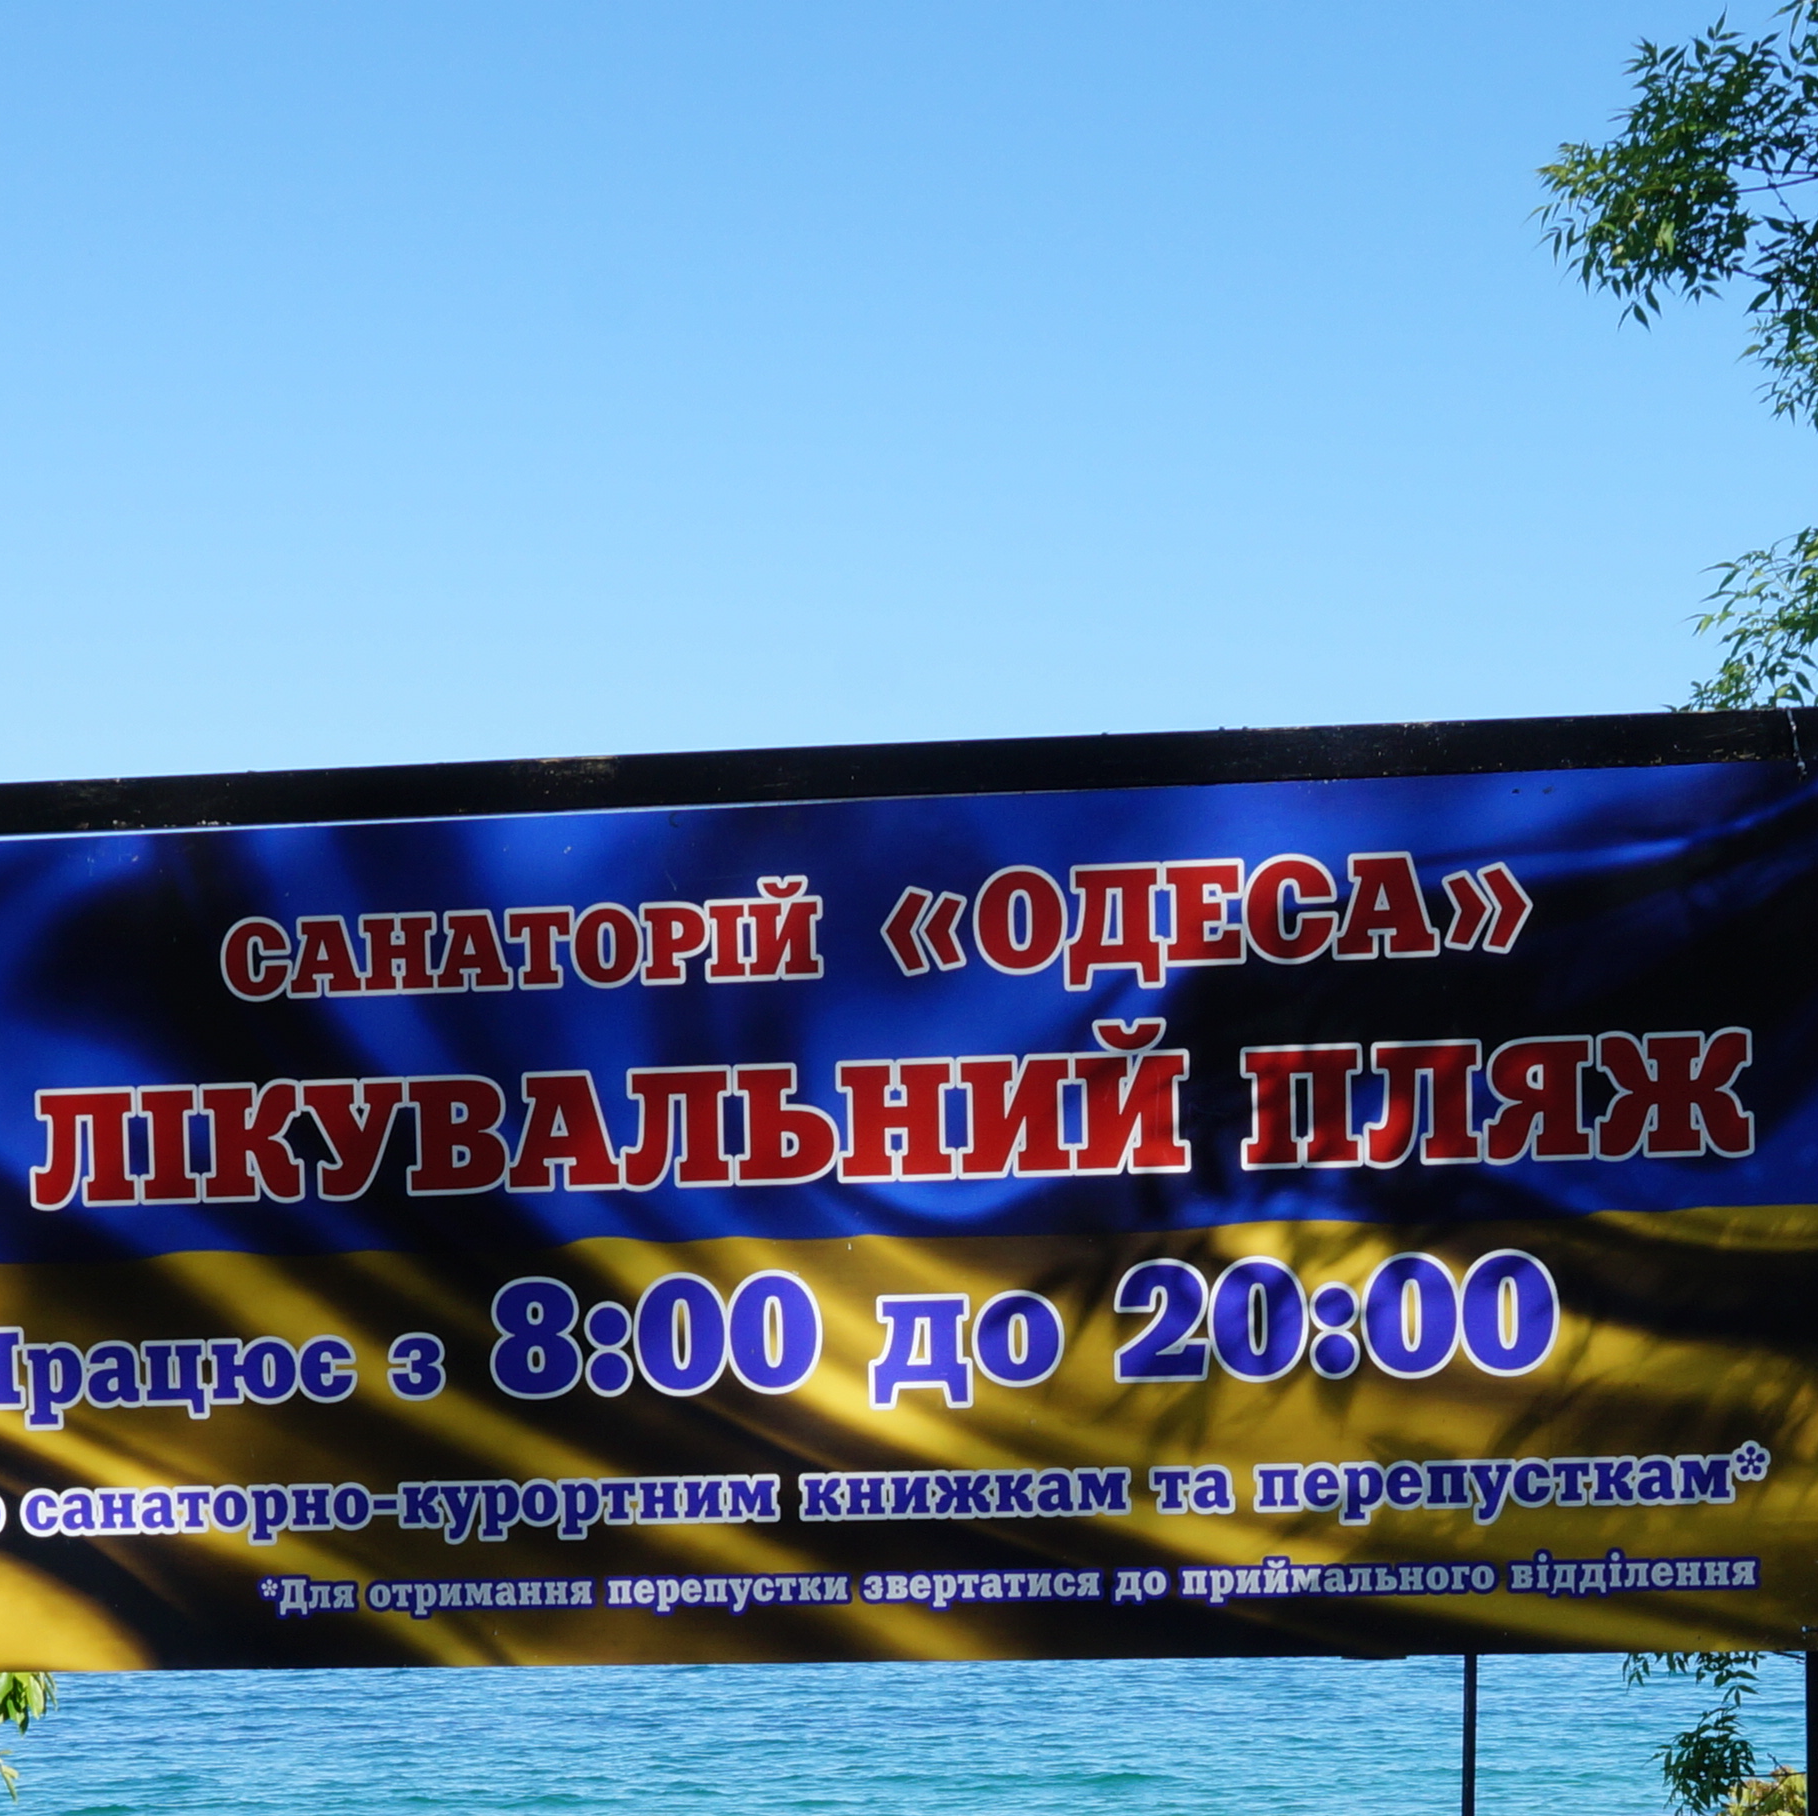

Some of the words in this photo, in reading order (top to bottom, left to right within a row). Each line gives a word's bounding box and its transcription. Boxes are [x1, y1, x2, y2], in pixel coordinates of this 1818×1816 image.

[221, 877, 824, 1000] САНАТОРІЙ
[880, 852, 1533, 991] «ОДЕСА»
[31, 1017, 1190, 1210] ЛІКУВАЛЬНИЙ
[1241, 1026, 1755, 1171] ПЛЯЖ
[386, 1332, 445, 1401] з
[488, 1270, 824, 1399] 8:00
[868, 1289, 1065, 1410] до
[1113, 1247, 1559, 1383] 20:00
[20, 1473, 780, 1546] санаторно-курортним
[799, 1463, 1131, 1521] книжкам
[1149, 1464, 1233, 1515] та
[367, 1571, 593, 1619] отримання
[604, 1568, 849, 1617] перепустки
[860, 1566, 1101, 1607] звертатися
[1114, 1567, 1167, 1603] до
[1180, 1555, 1497, 1602] приймального
[1508, 1549, 1759, 1597] відділення
